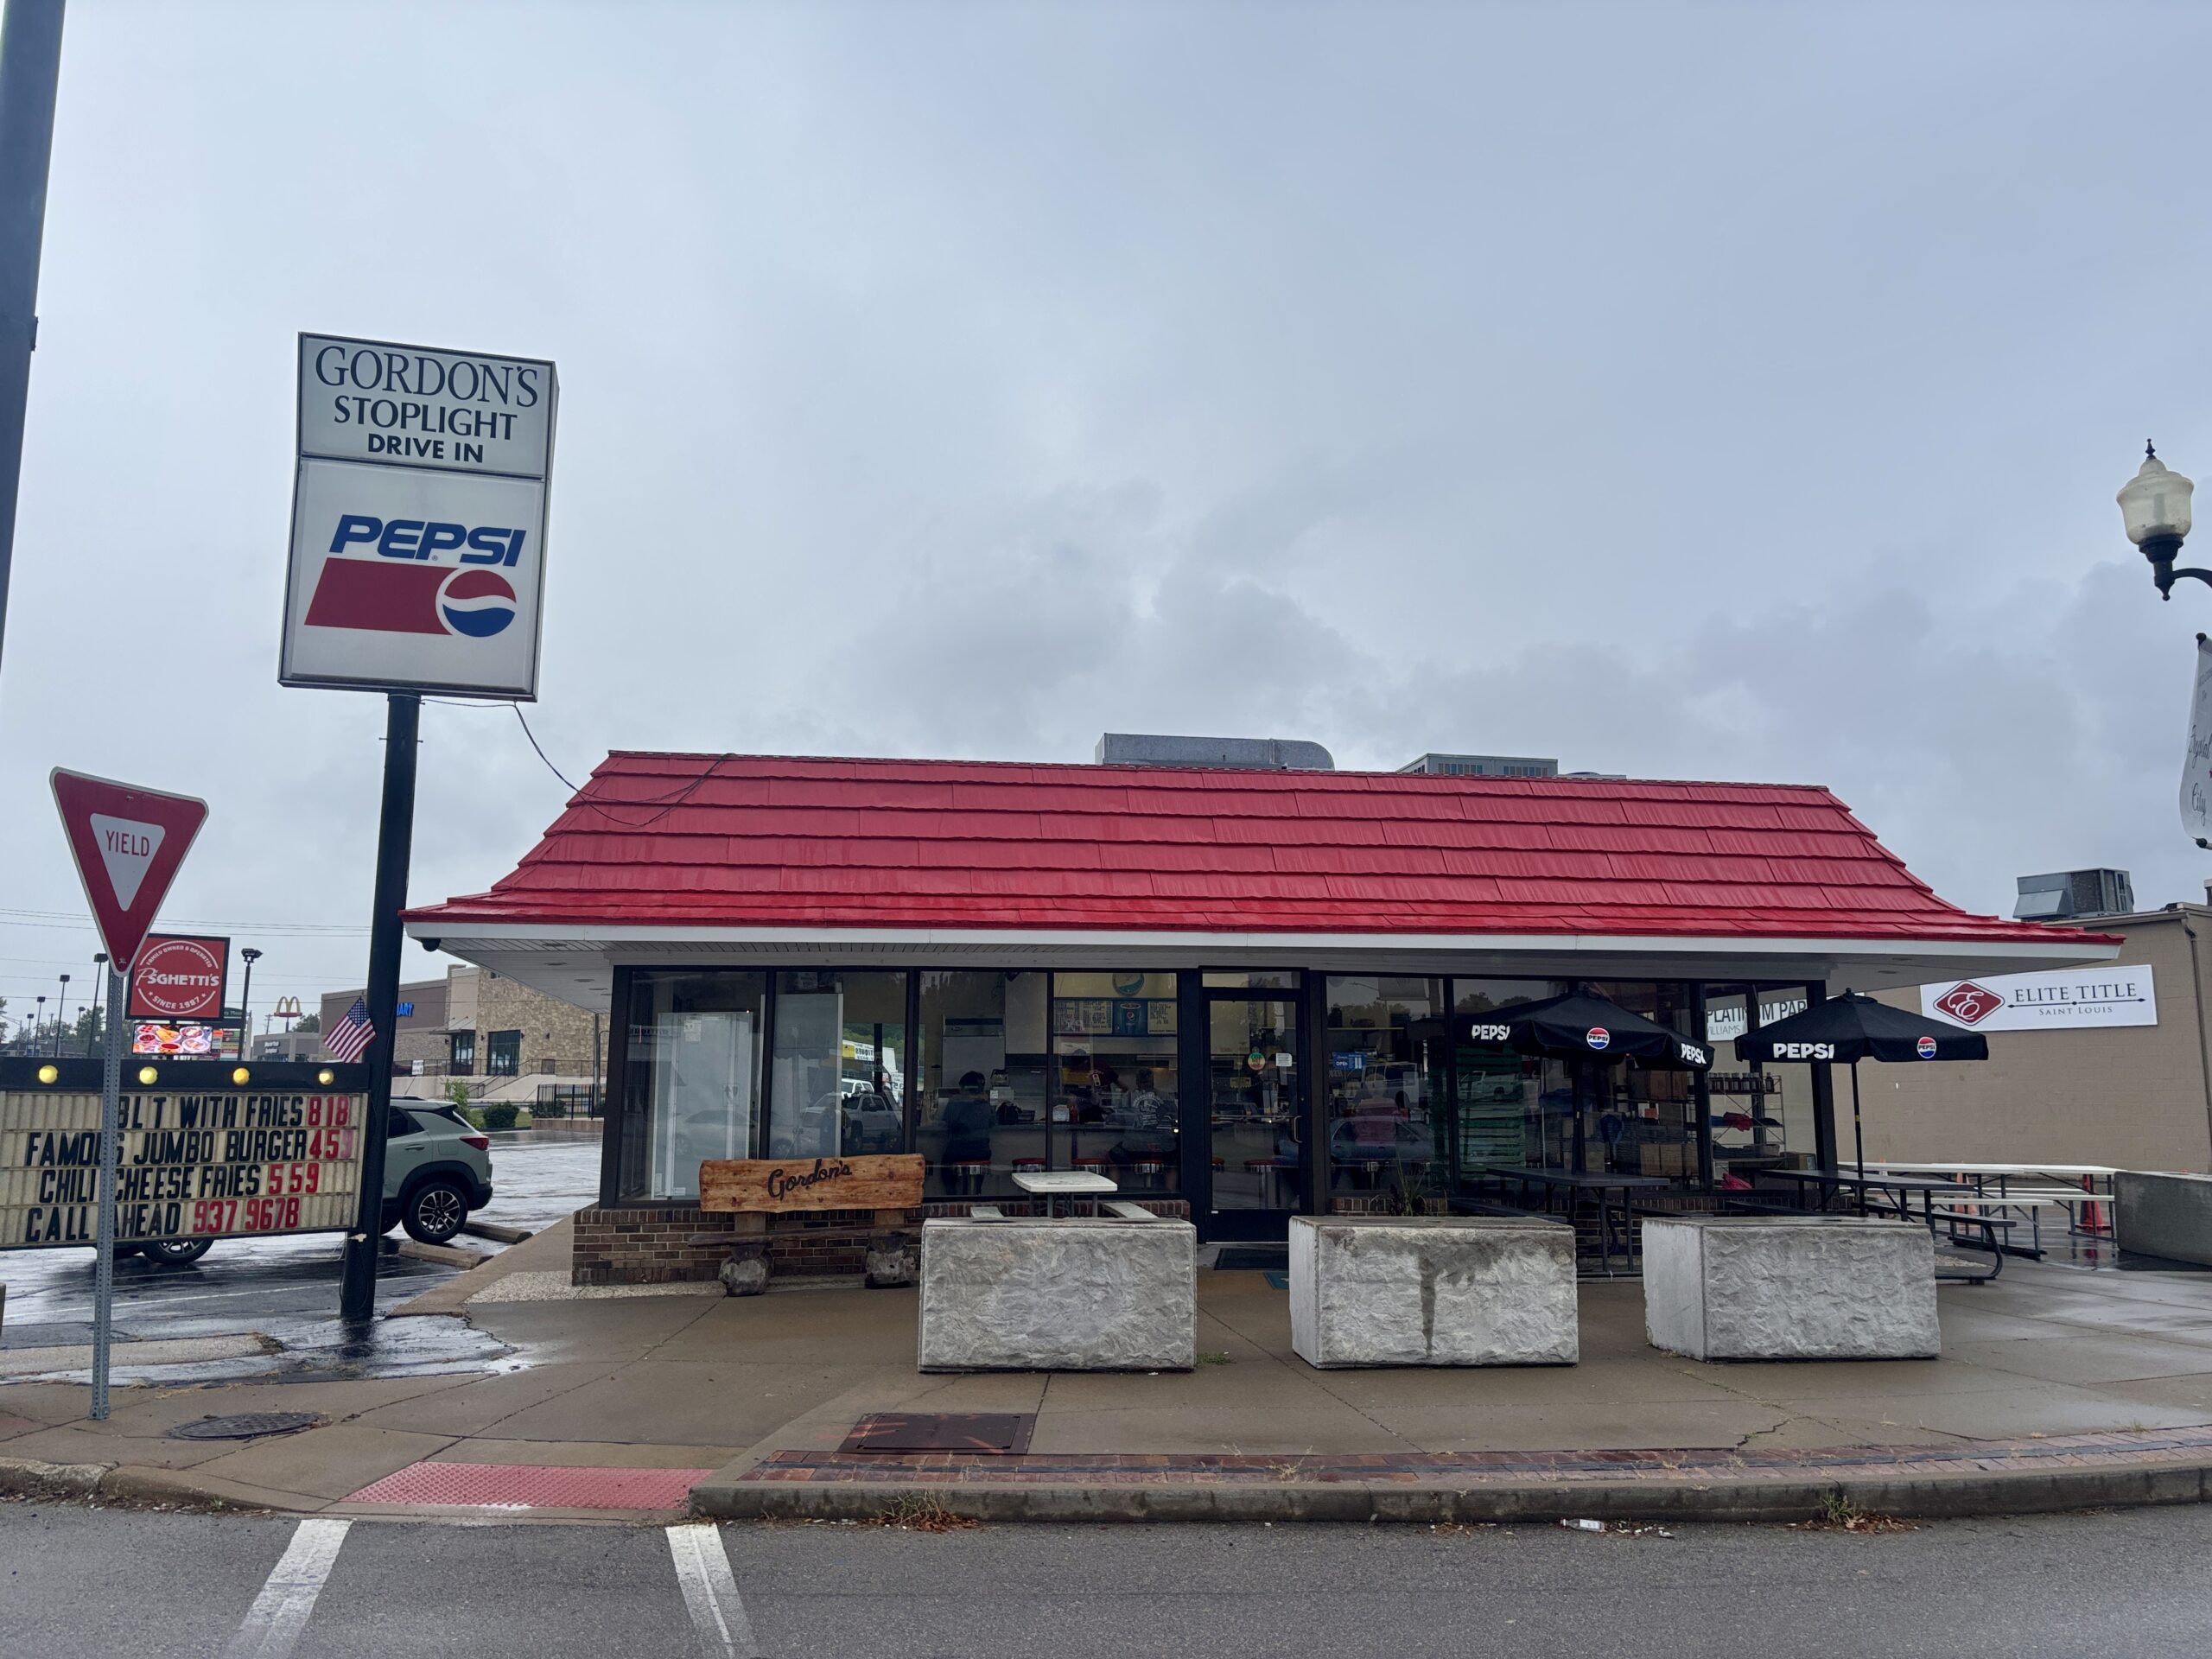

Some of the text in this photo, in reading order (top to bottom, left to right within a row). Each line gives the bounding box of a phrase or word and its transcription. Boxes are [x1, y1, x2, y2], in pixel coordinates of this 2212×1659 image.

[315, 346, 539, 408] GORDON'S
[334, 395, 518, 441] STOPLIGHT
[368, 433, 484, 463] DRIVE IN
[328, 513, 527, 567] PEPSI
[2192, 782, 2207, 827] City
[105, 829, 150, 857] YIELD
[146, 950, 163, 965] FAMILY
[162, 944, 184, 953] OWNED
[189, 947, 213, 968] OPERATED
[152, 995, 176, 1009] SINCE
[2014, 982, 2137, 1002] ELITE TITLE
[397, 1001, 413, 1017] ART
[1707, 1003, 1775, 1023] PLATINM
[1471, 1025, 1510, 1041] PEPSI
[1681, 1043, 1707, 1065] PEPSI
[1772, 1043, 1835, 1059] PEPSI
[180, 1096, 238, 1128] WITH
[246, 1096, 304, 1127] FRIES
[307, 1096, 350, 1127] 818
[133, 1130, 214, 1165] JUMBO
[225, 1128, 307, 1162] BURGER
[39, 1162, 320, 1203] CHILI CHEESE FRIES 559
[767, 1158, 853, 1202] Gordon's
[25, 1206, 90, 1243] CALL
[193, 1199, 238, 1233] 937
[245, 1197, 299, 1230] 9678
